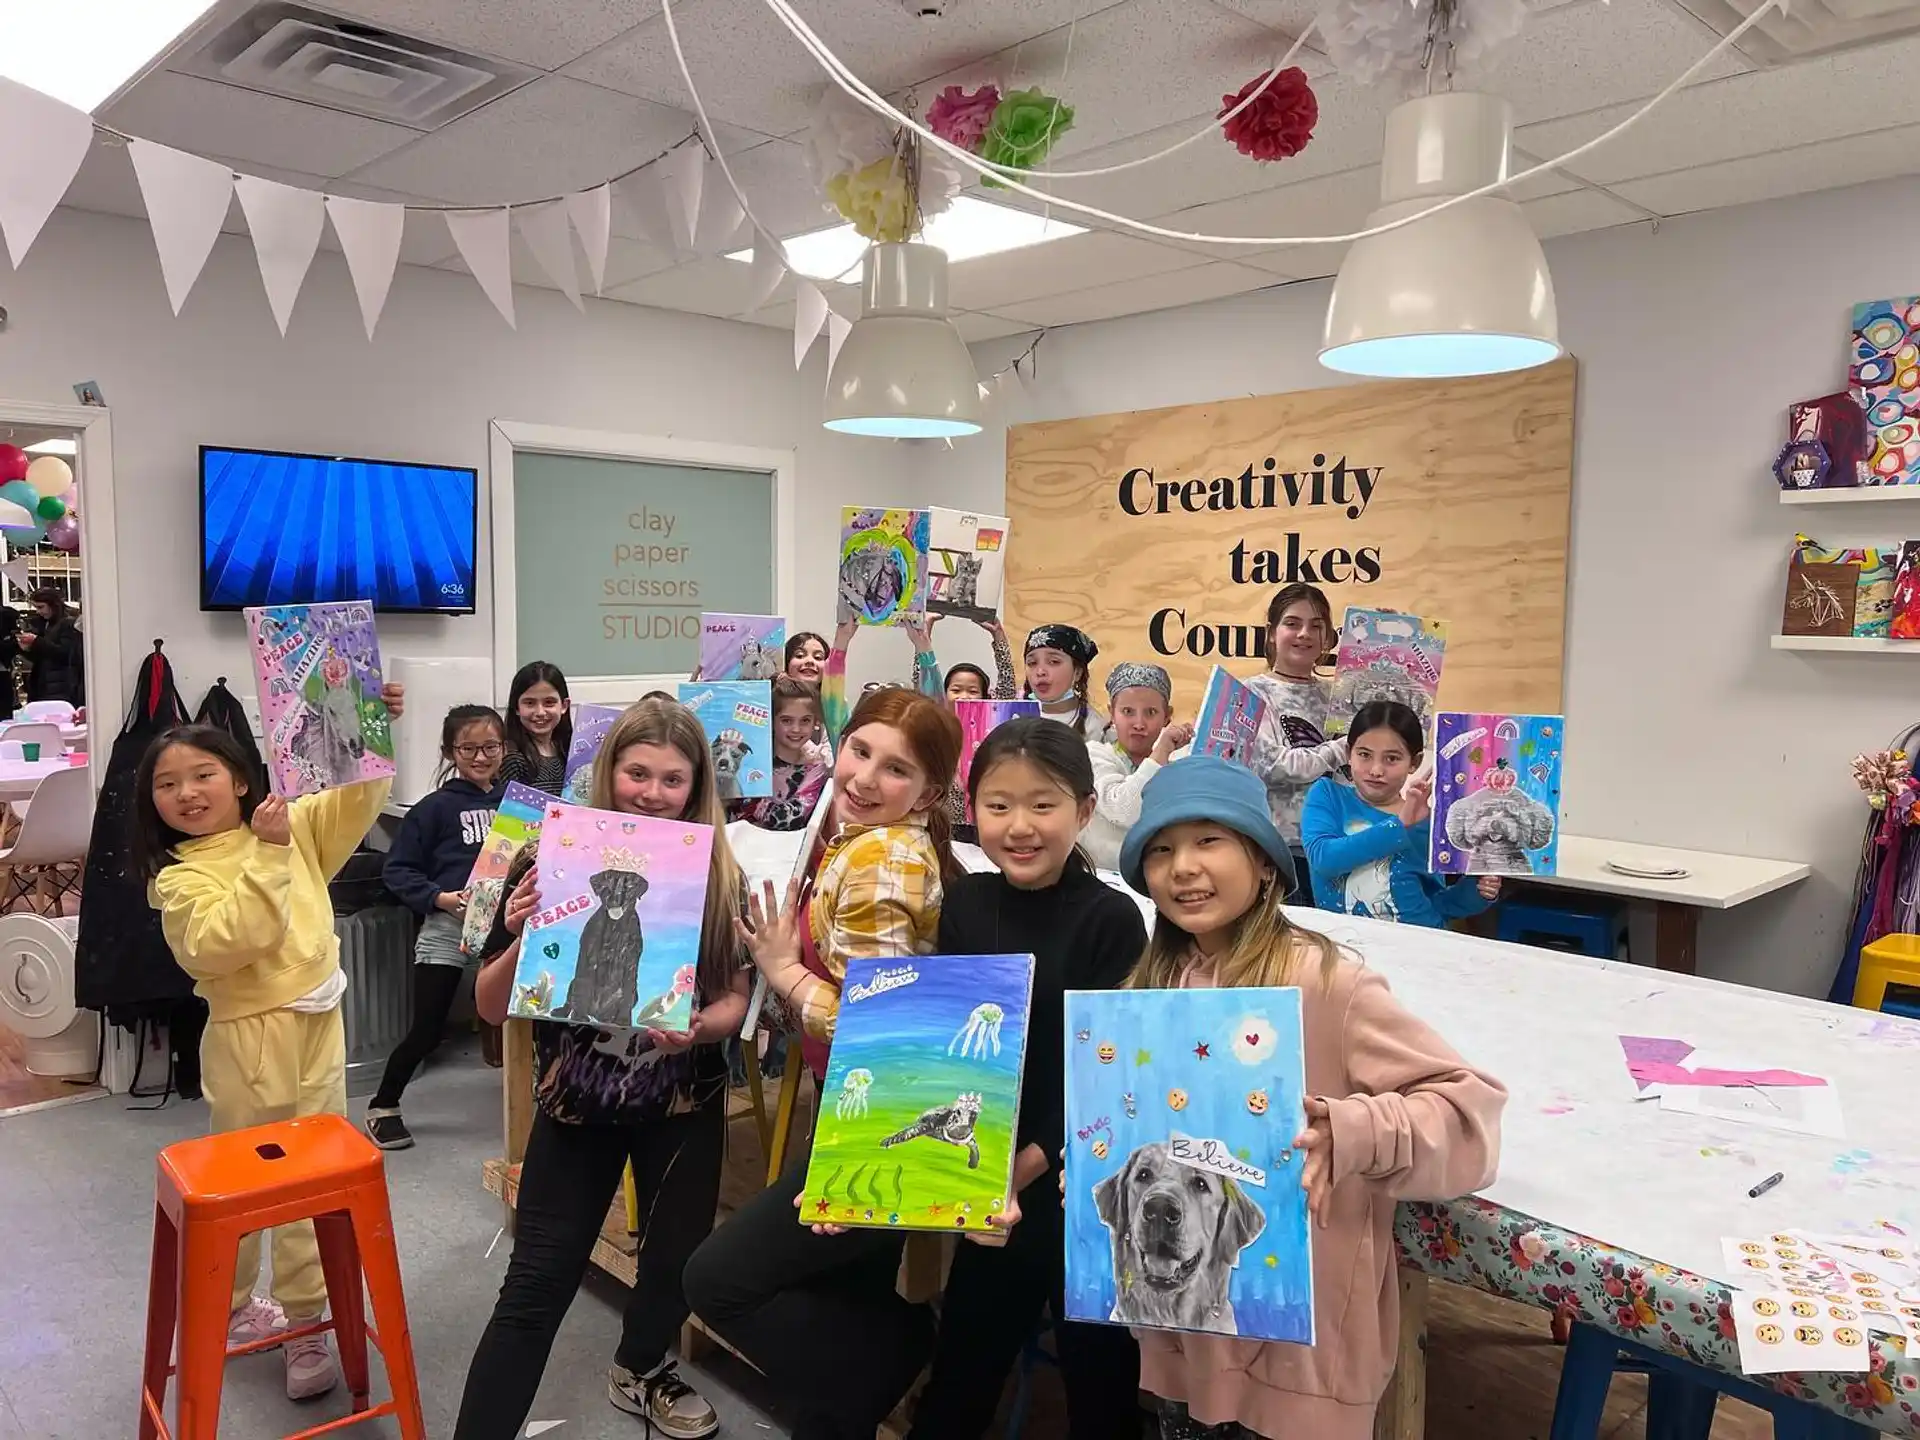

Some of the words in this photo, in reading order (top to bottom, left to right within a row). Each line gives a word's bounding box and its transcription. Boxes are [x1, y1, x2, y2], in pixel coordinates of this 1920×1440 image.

[1118, 453, 1385, 520] Creativity
[628, 504, 676, 539] clay
[614, 543, 690, 569] paper
[1229, 532, 1382, 584] takes
[441, 583, 464, 595] 6:36
[603, 573, 699, 598] scissors
[602, 614, 701, 640] STUDIO
[706, 624, 736, 634] PEACE
[261, 632, 304, 668] PEACE
[736, 703, 769, 719] PEACE
[529, 895, 590, 930] PEACE
[1171, 1139, 1265, 1182] Believe
